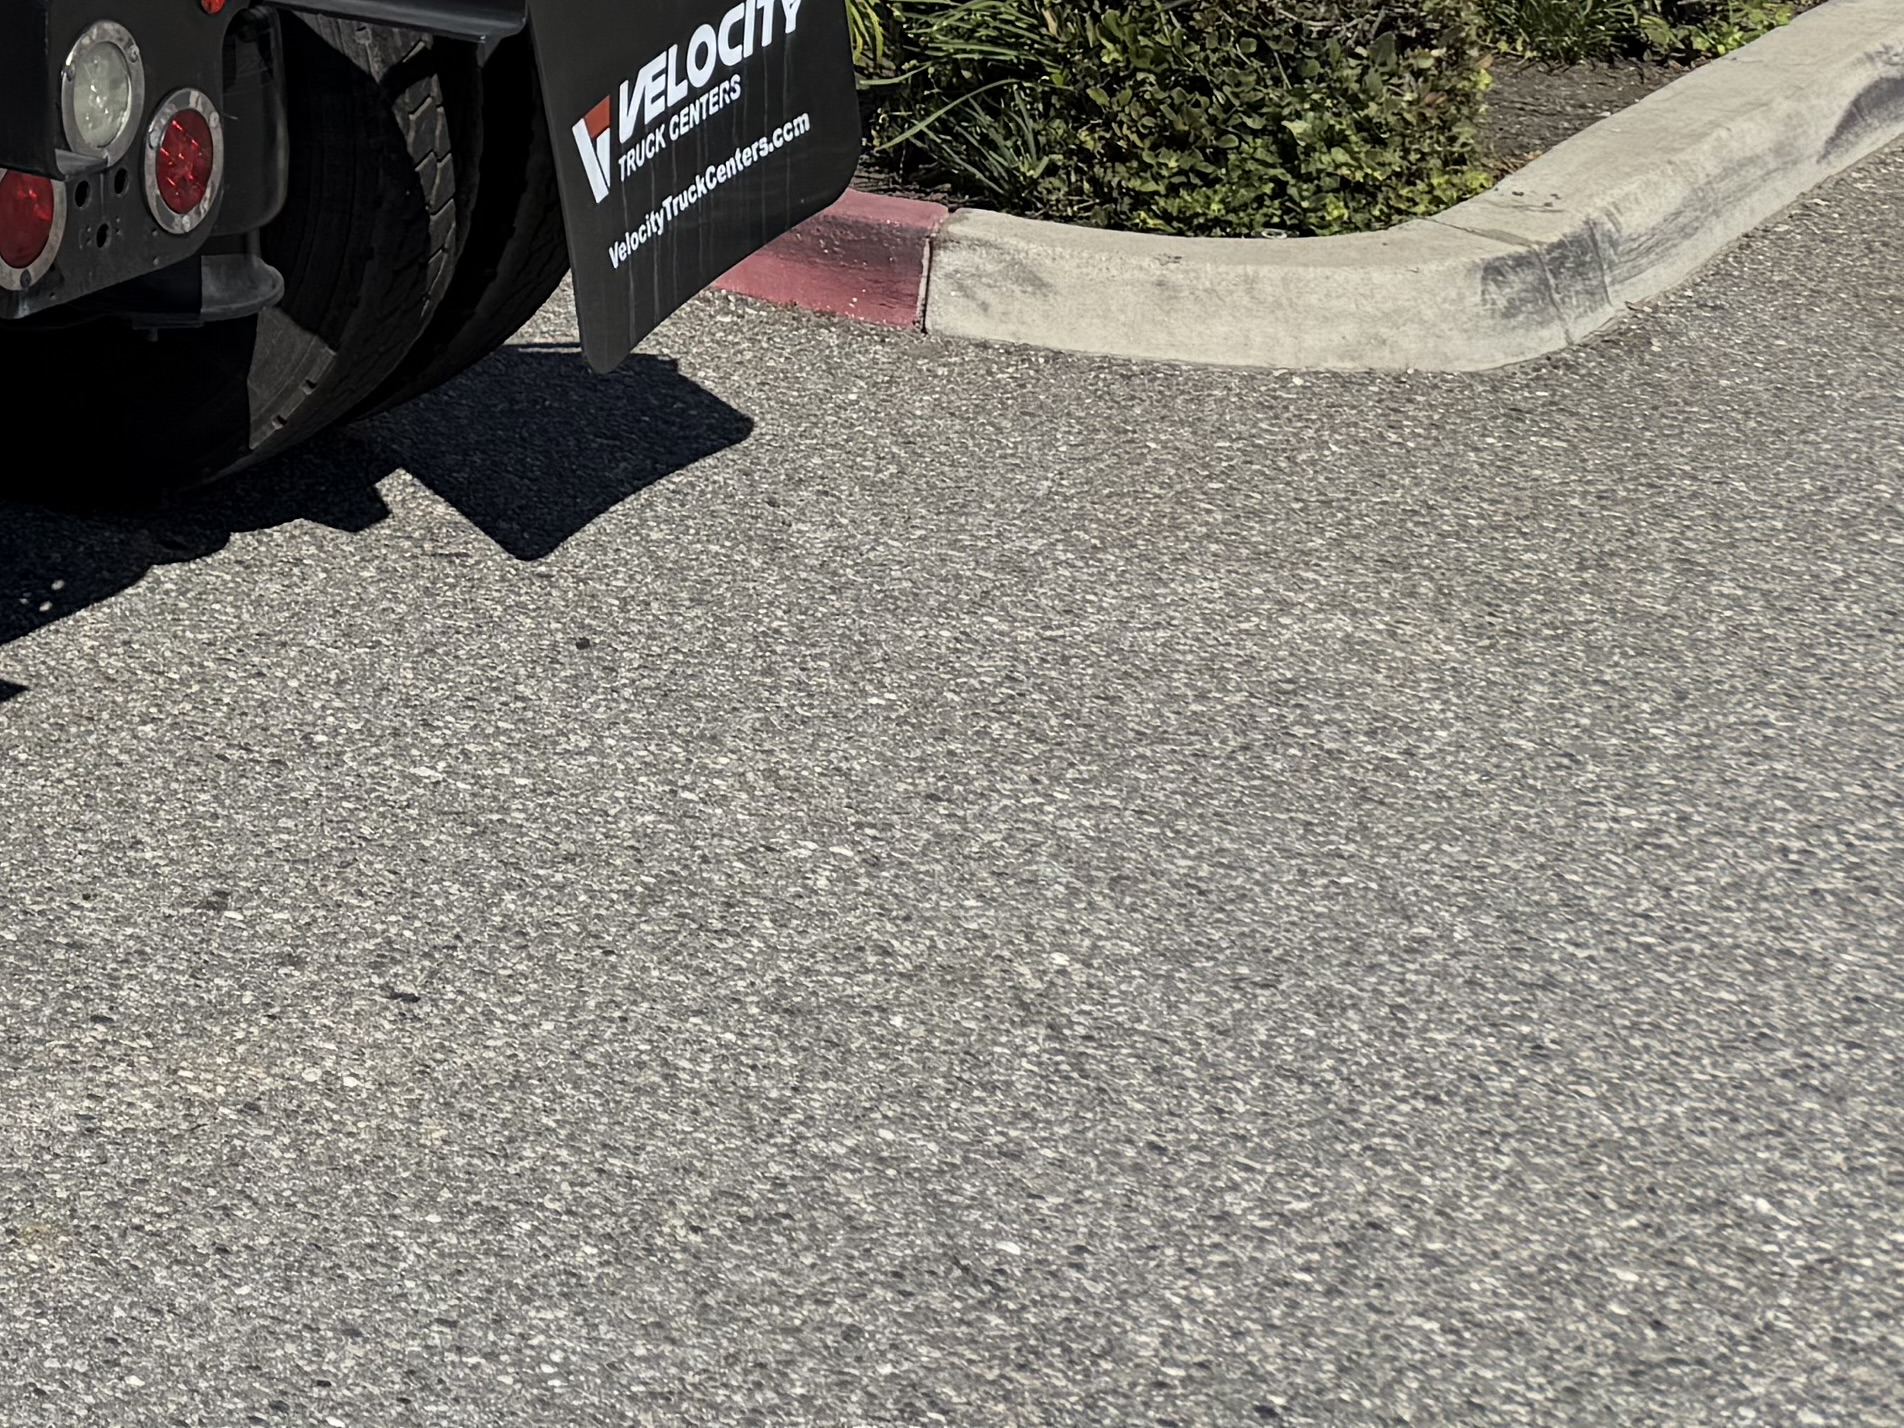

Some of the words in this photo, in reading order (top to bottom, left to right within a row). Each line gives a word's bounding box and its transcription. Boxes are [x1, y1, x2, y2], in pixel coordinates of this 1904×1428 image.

[608, 112, 811, 269] VelocityTruckCenters.com
[618, 128, 666, 182] TRUCK
[669, 74, 741, 142] CENTERS
